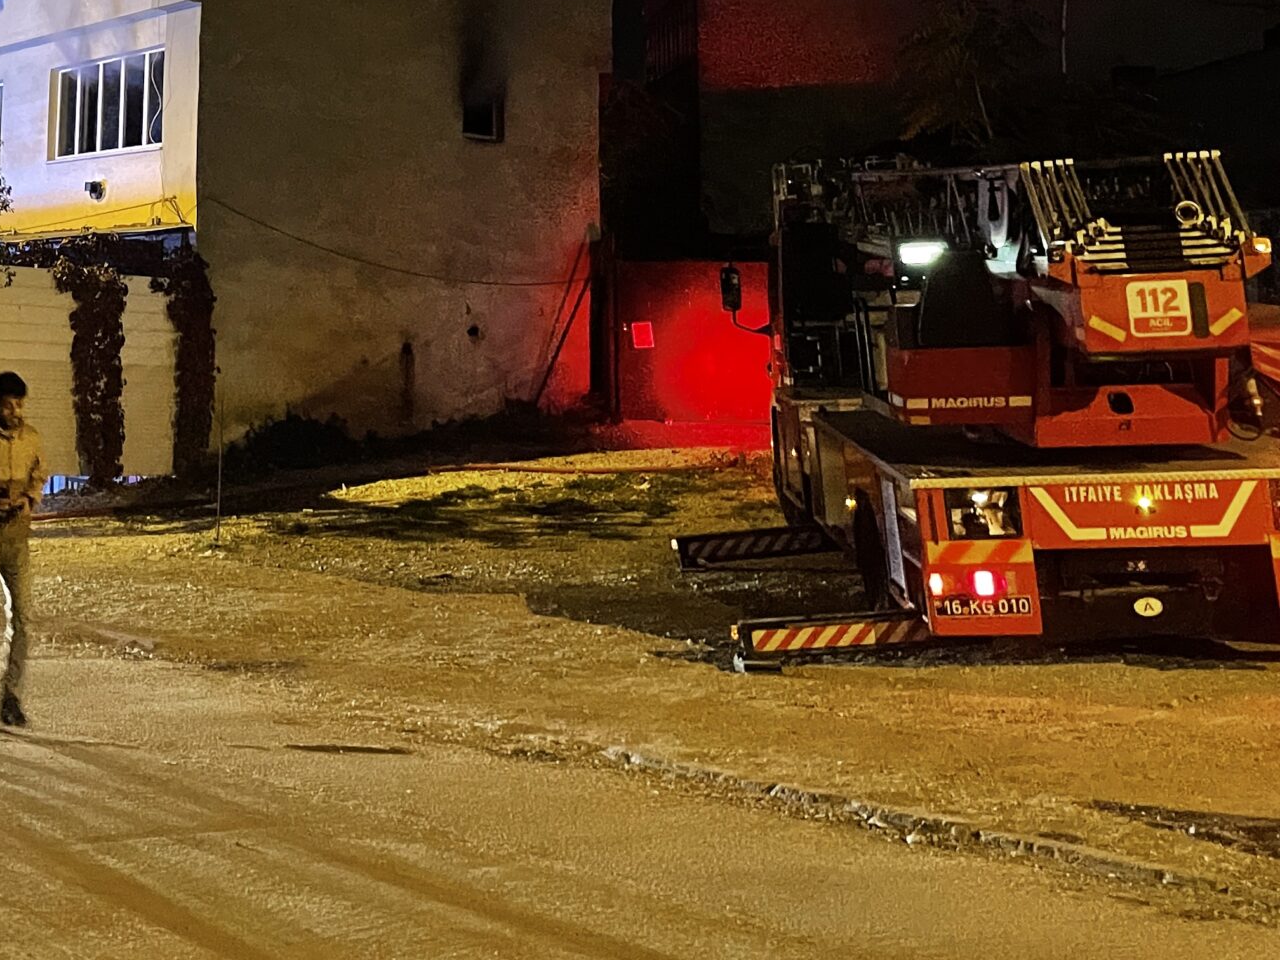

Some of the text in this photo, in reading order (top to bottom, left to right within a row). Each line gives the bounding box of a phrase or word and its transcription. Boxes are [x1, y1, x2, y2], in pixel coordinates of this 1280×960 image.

[1136, 287, 1181, 314] 112
[1109, 526, 1188, 540] MAGIRUS
[999, 598, 1029, 614] 010
